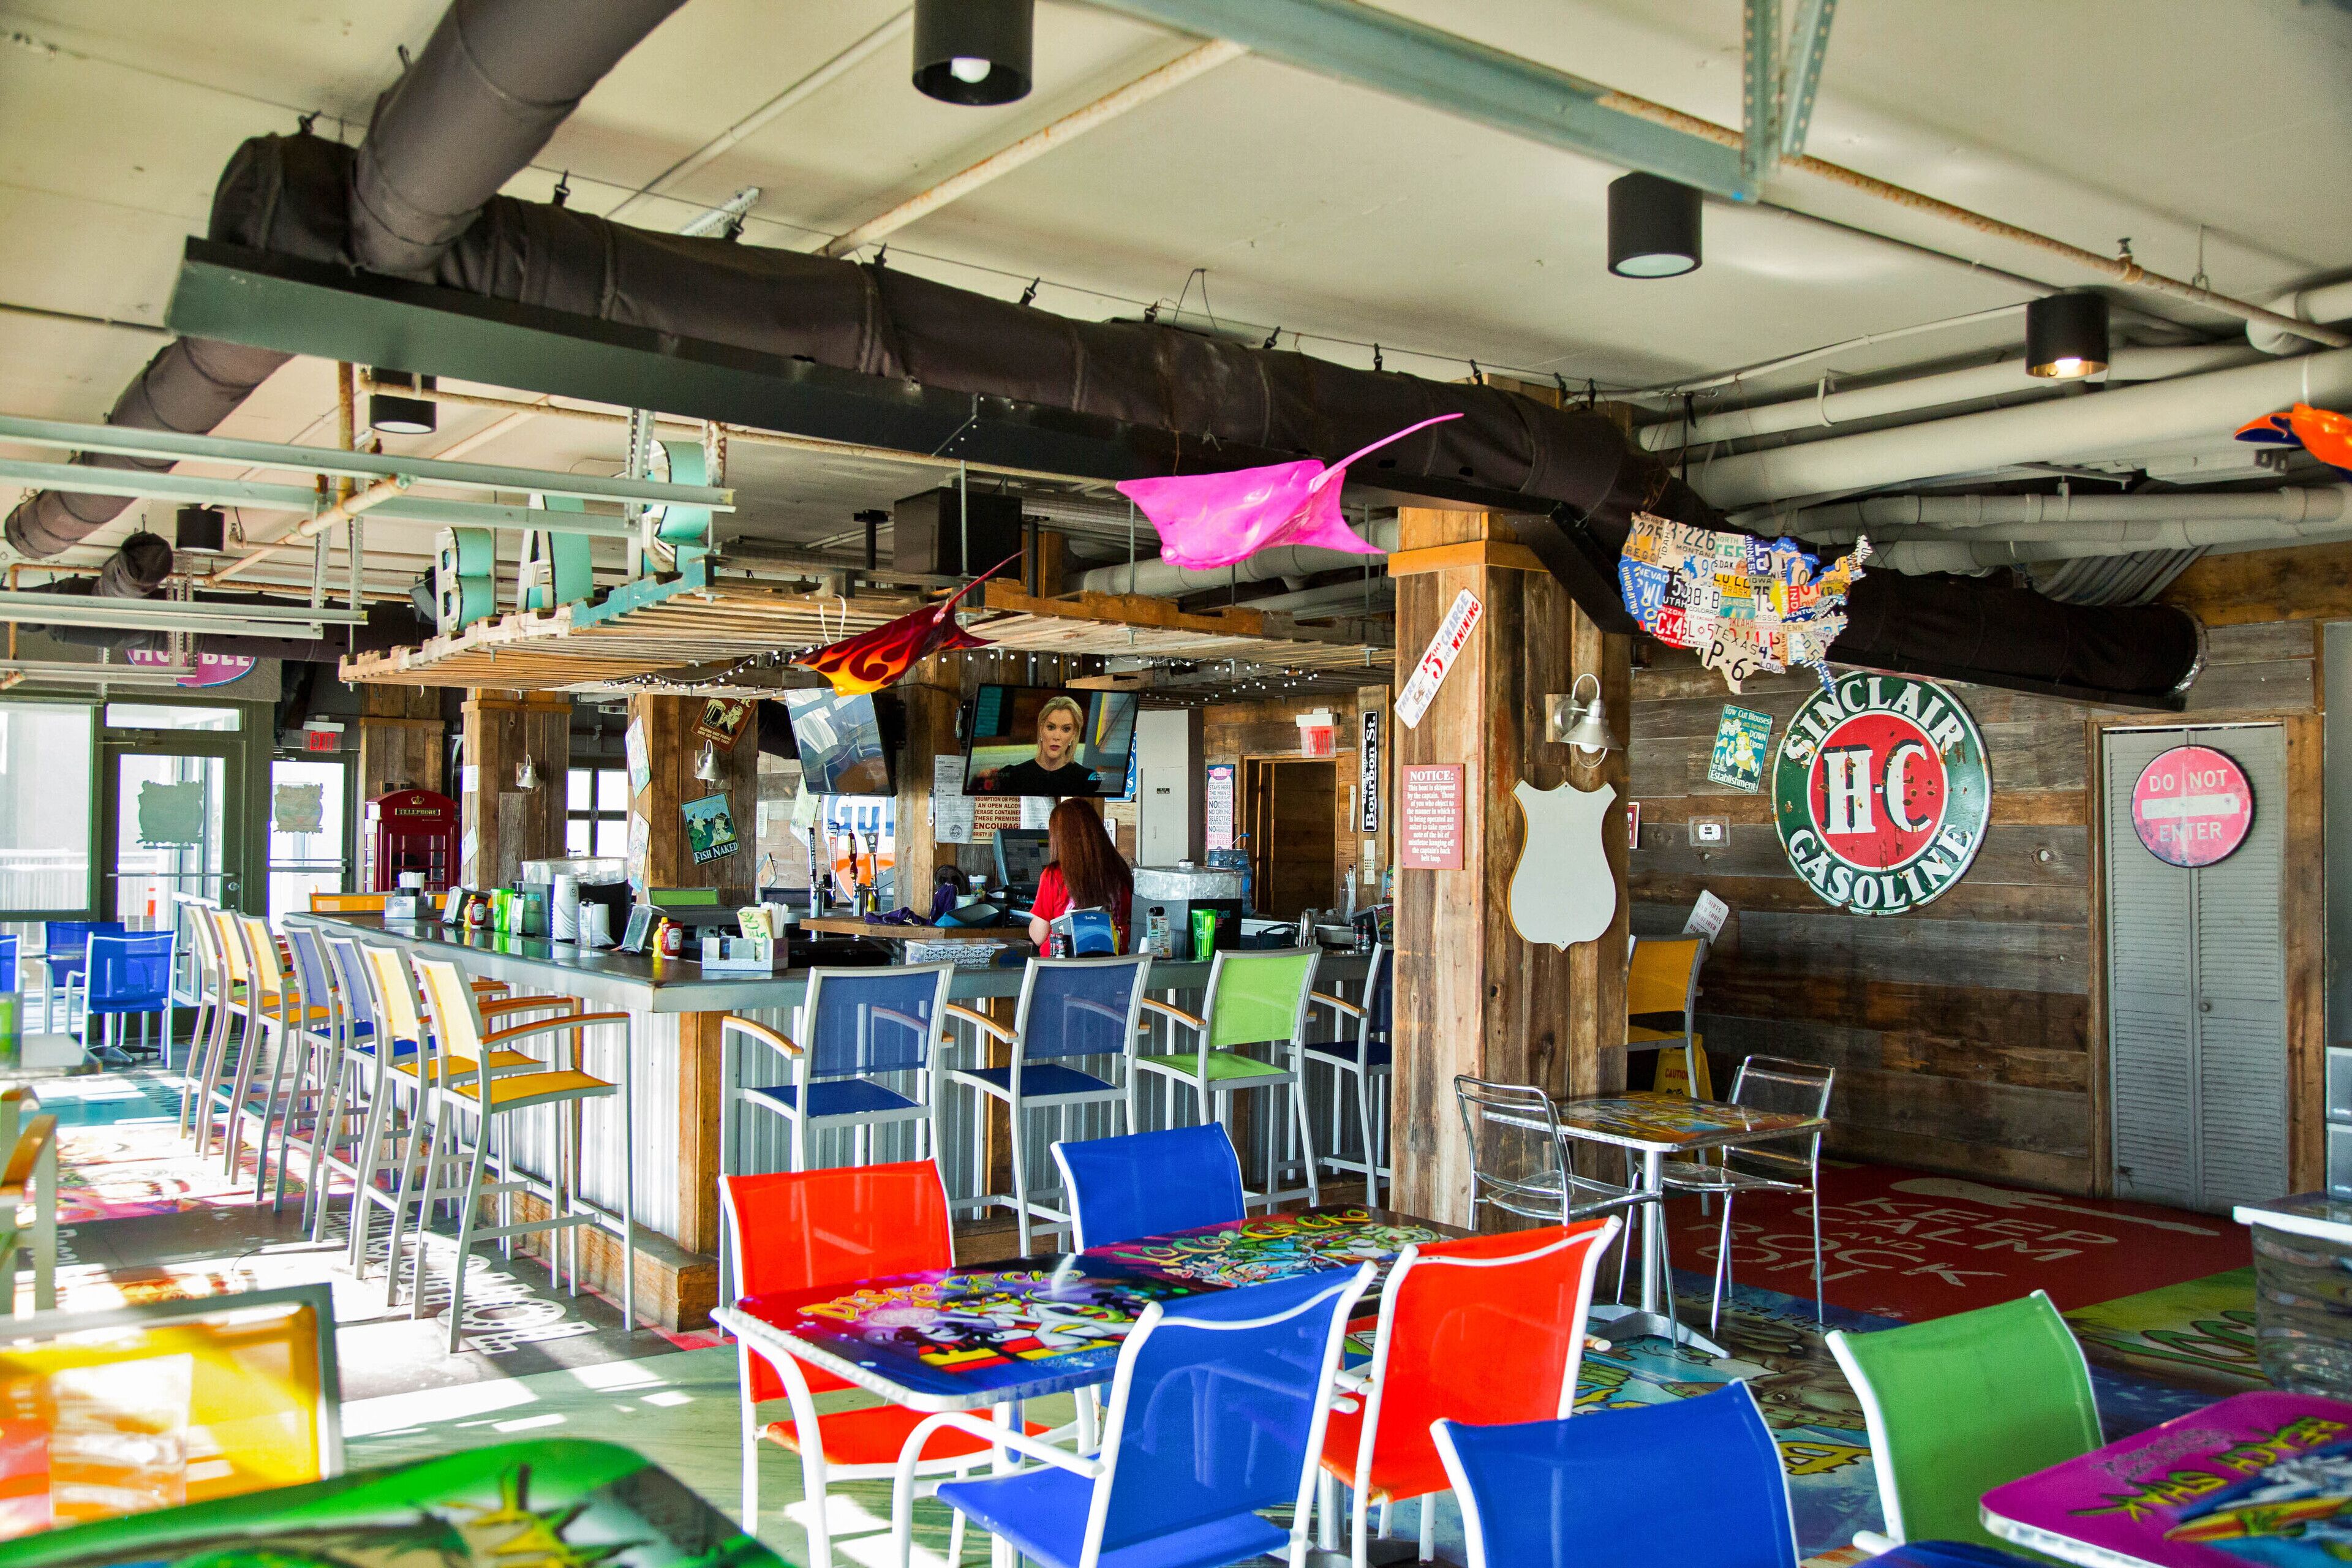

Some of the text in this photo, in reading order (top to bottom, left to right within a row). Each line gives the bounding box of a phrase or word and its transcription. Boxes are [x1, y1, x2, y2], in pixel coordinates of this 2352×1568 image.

[1622, 565, 1640, 616] CALIFORNIA
[1441, 594, 1469, 646] CHARGE
[1444, 601, 1479, 662] FOR WHINING
[1715, 624, 1759, 656] TEXAS
[134, 649, 250, 666] HUBLE
[1398, 680, 1416, 714] THERE
[1414, 701, 1426, 720] WILL
[1425, 690, 1433, 701] BE
[1366, 715, 1376, 742] St.
[1738, 710, 1747, 719] Cut
[1749, 713, 1771, 725] Blouses
[1785, 676, 1966, 766] SINCLAIR
[309, 732, 336, 751] EXIT
[1307, 729, 1330, 755] EXIT
[1749, 730, 1766, 741] DOWN
[1410, 771, 1454, 781] NOTICE:
[1710, 770, 1756, 791] Establishment
[2149, 769, 2228, 792] DO NOT
[2159, 822, 2222, 842] ENTER
[695, 842, 738, 864] FISH NAKED
[1789, 824, 1973, 908] GASOLINE
[1792, 1205, 2083, 1262] CALM
[1846, 1197, 2119, 1245] KEEP
[1685, 1221, 2008, 1287] ROCK
[1829, 1231, 1926, 1250] AND
[1695, 1243, 1869, 1282] ON
